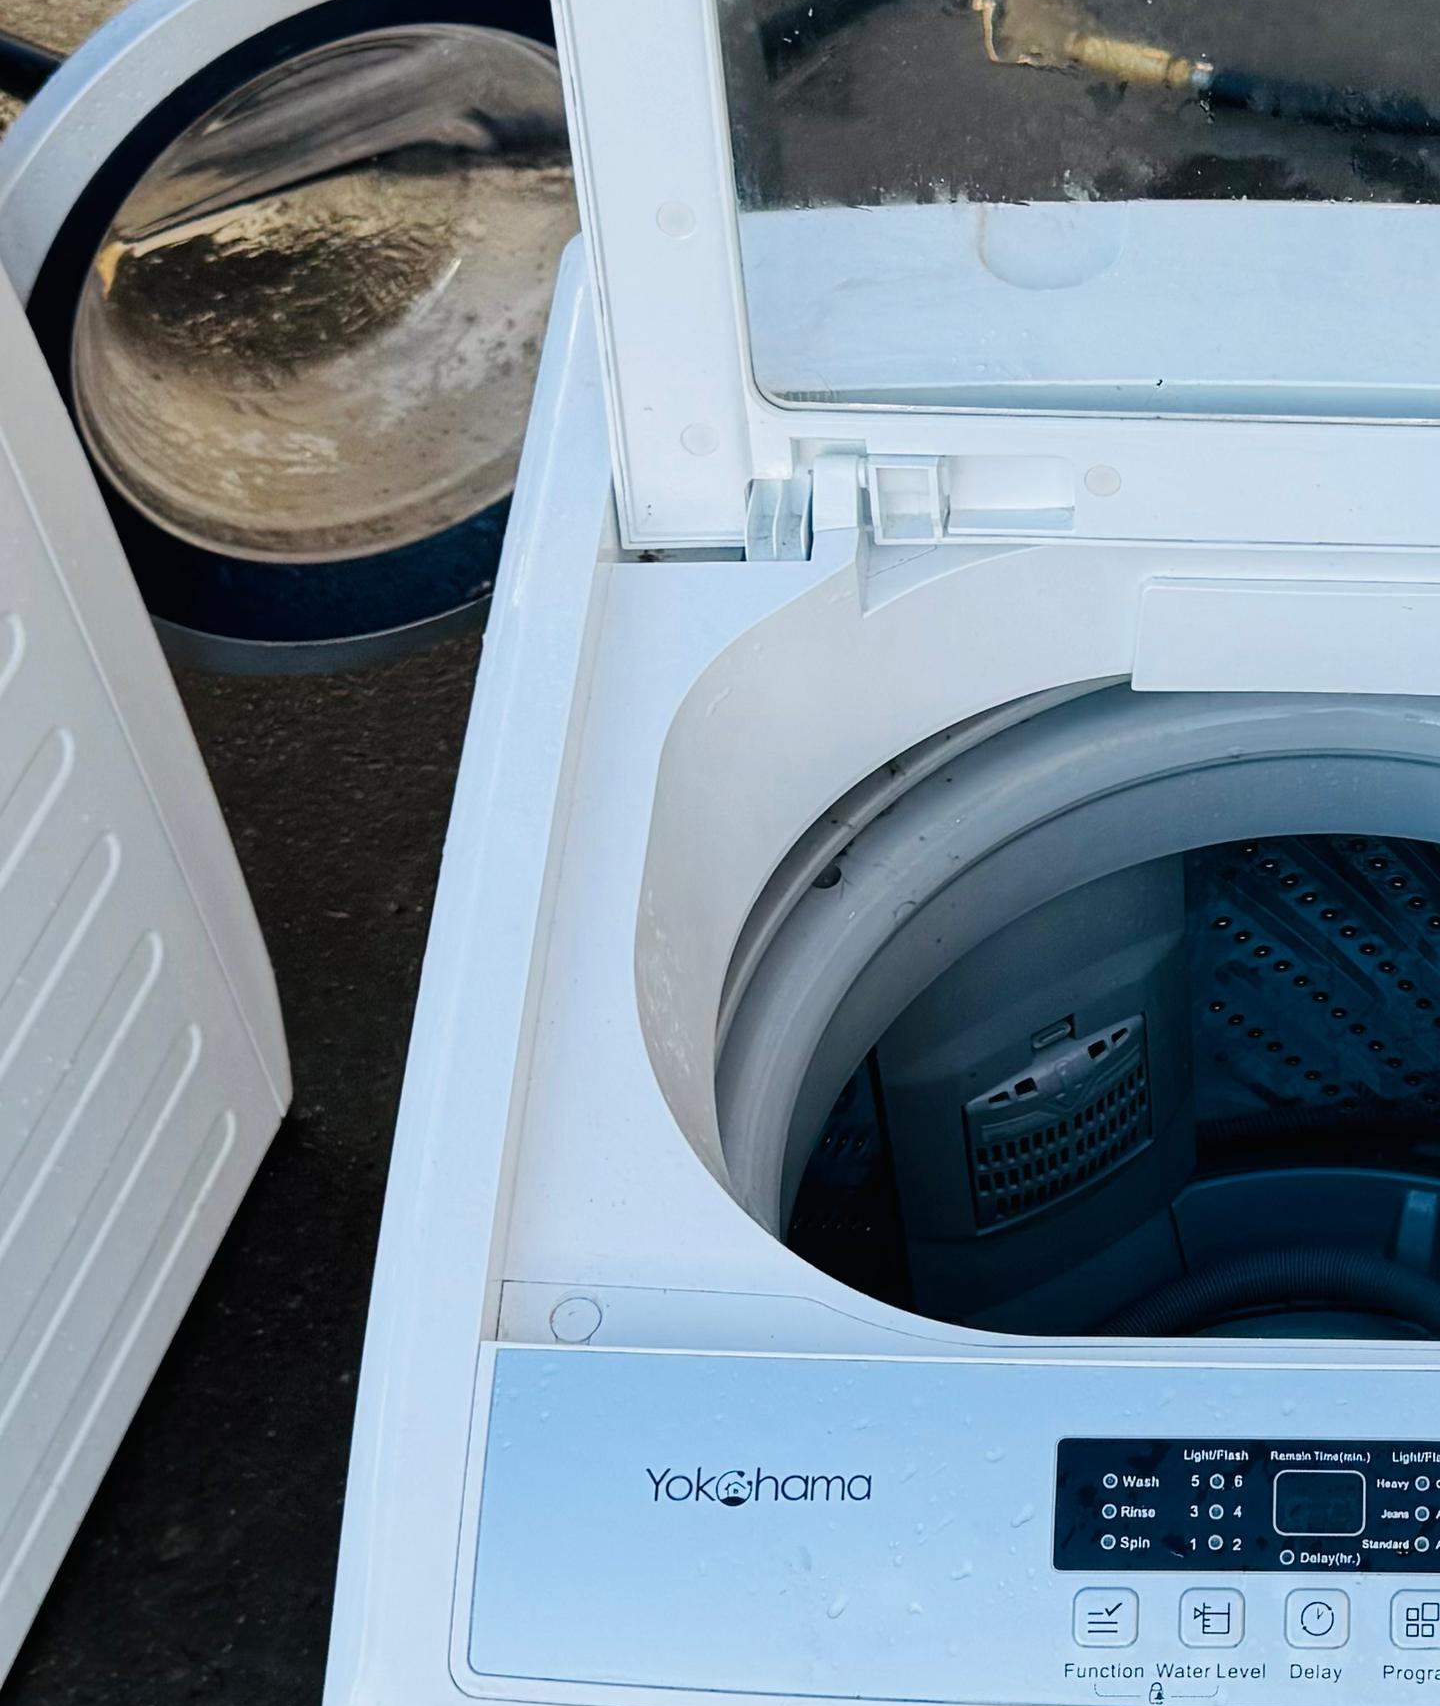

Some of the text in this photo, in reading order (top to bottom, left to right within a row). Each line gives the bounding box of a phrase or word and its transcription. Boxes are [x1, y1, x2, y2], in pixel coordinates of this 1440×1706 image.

[1183, 1449, 1249, 1462] Light/Flash
[1270, 1450, 1371, 1464] Remain Time(min.)
[1122, 1475, 1160, 1488] Wash
[1191, 1475, 1201, 1488] 5
[1233, 1475, 1243, 1488] 6
[1376, 1479, 1410, 1491] Heavy
[1120, 1506, 1156, 1518] Rinse
[1189, 1506, 1199, 1518] 3
[1233, 1506, 1243, 1518] 4
[1380, 1509, 1410, 1520] Jeans
[1119, 1536, 1151, 1550] Spin
[1189, 1538, 1197, 1550] 1
[1232, 1538, 1242, 1550] 2
[1361, 1538, 1410, 1550] Standard
[1300, 1552, 1361, 1566] Delay(hr.)
[1064, 1663, 1145, 1679] Function
[1156, 1663, 1266, 1680] Water Level
[1290, 1665, 1342, 1683] Delay
